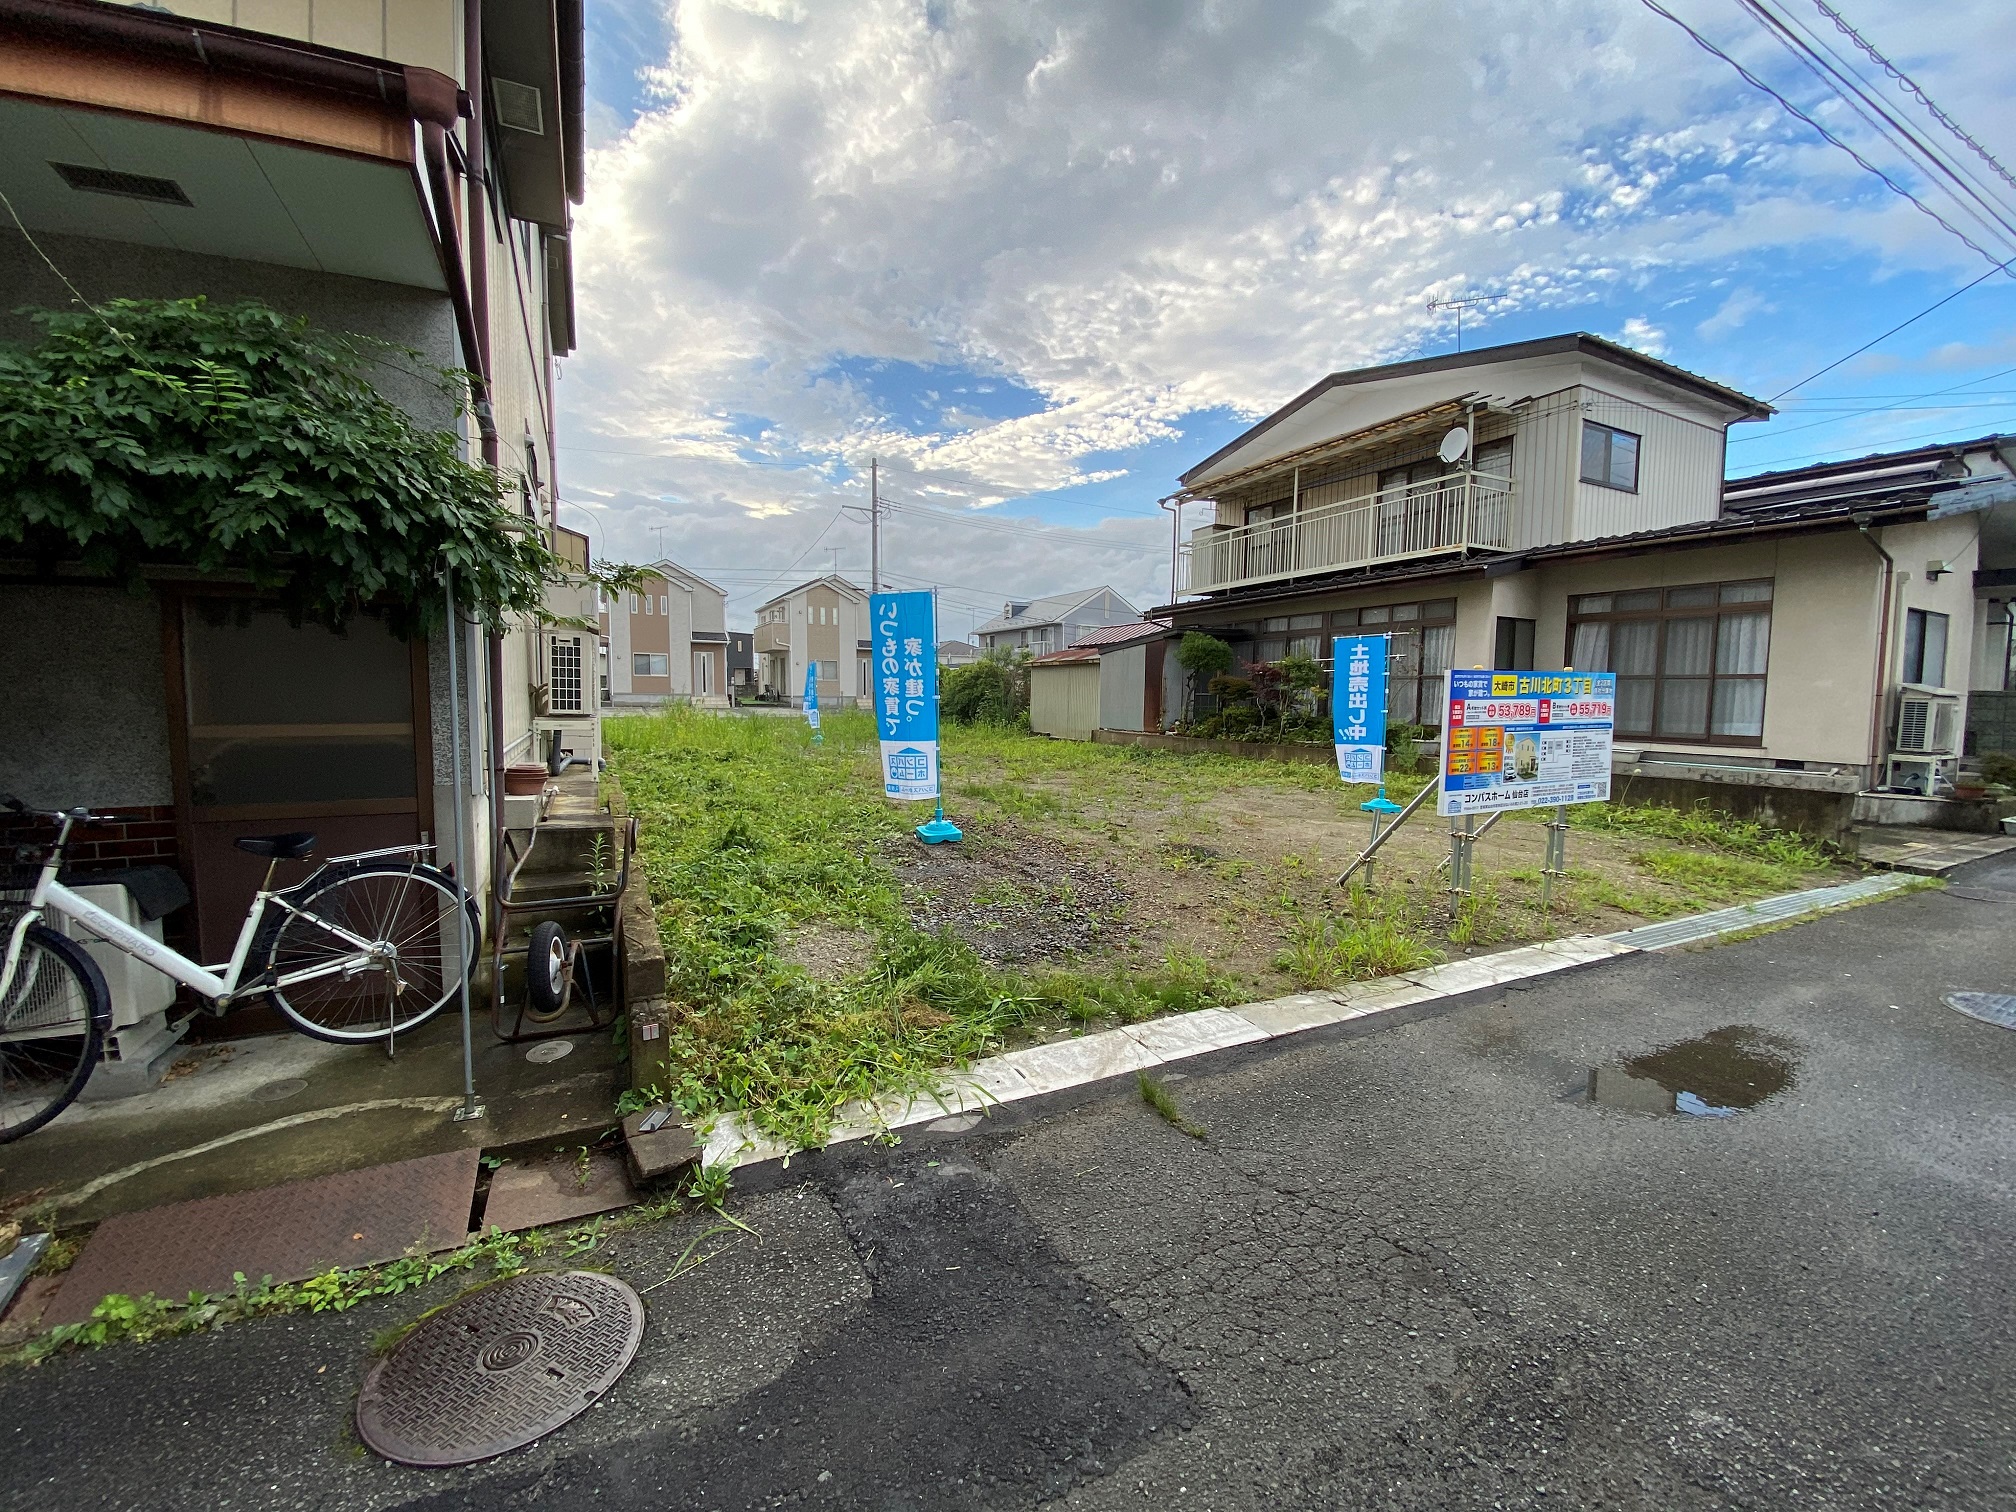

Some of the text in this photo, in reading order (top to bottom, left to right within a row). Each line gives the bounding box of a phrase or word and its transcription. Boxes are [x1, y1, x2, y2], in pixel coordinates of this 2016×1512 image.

[1494, 680, 1516, 692] 大崎市
[1519, 677, 1592, 694] 古川北町3丁目
[1465, 790, 1511, 804] コンパスホーム
